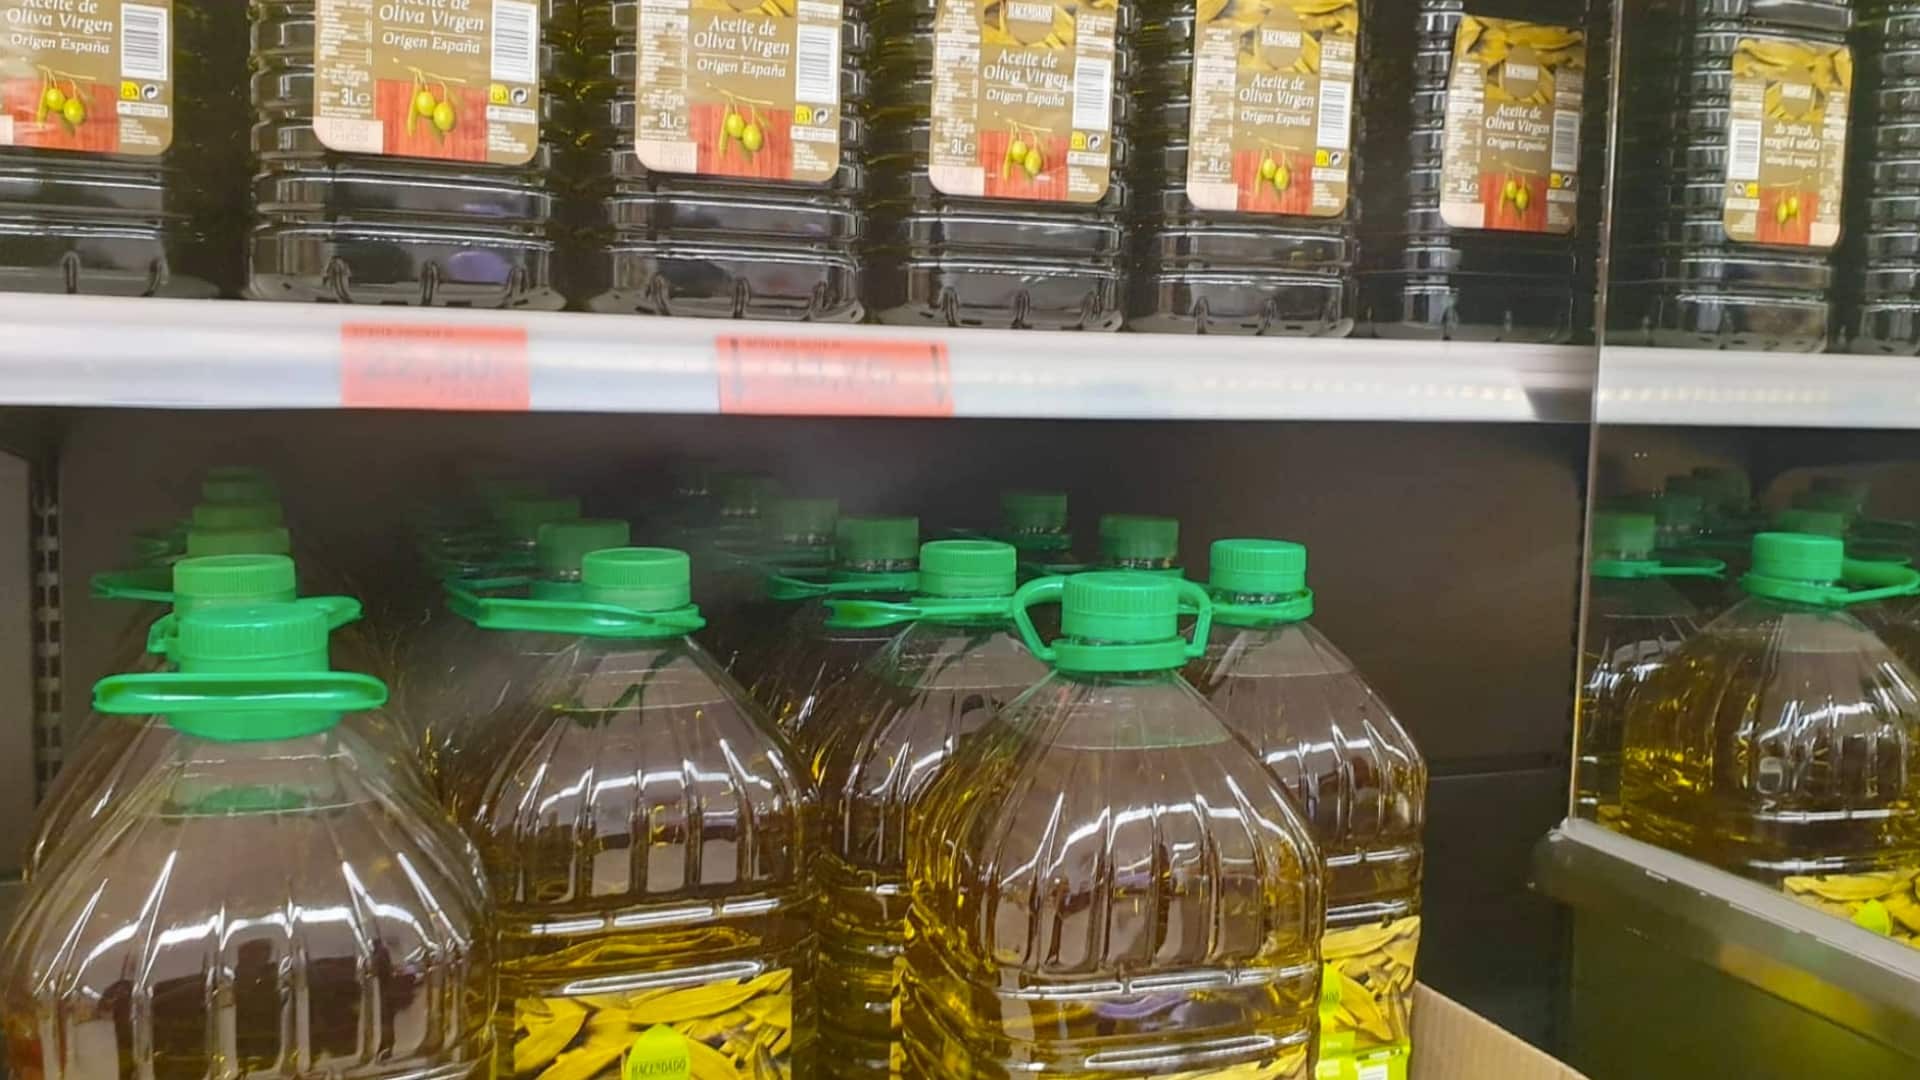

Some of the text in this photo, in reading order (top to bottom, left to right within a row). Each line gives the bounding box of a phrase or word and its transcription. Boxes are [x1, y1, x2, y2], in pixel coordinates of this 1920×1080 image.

[78, 0, 98, 14] de
[7, 8, 113, 35] Oliva Virgen
[379, 4, 484, 33] Oliva Virgen
[707, 15, 776, 37] Aceite de
[11, 33, 110, 55] Origen España
[383, 32, 481, 54] Origen España
[694, 32, 790, 57] Oliva Virgen
[697, 58, 786, 78] Origen España
[997, 49, 1058, 69] Aceite de
[983, 64, 1069, 89] Oliva Virgen
[1251, 73, 1305, 90] Aceite de
[986, 88, 1065, 108] Origen España
[1239, 87, 1314, 109] Oliva Virgen
[1241, 109, 1312, 127] Origen España
[1496, 104, 1543, 119] Aceite de
[1485, 115, 1550, 136] Oliva Virgen
